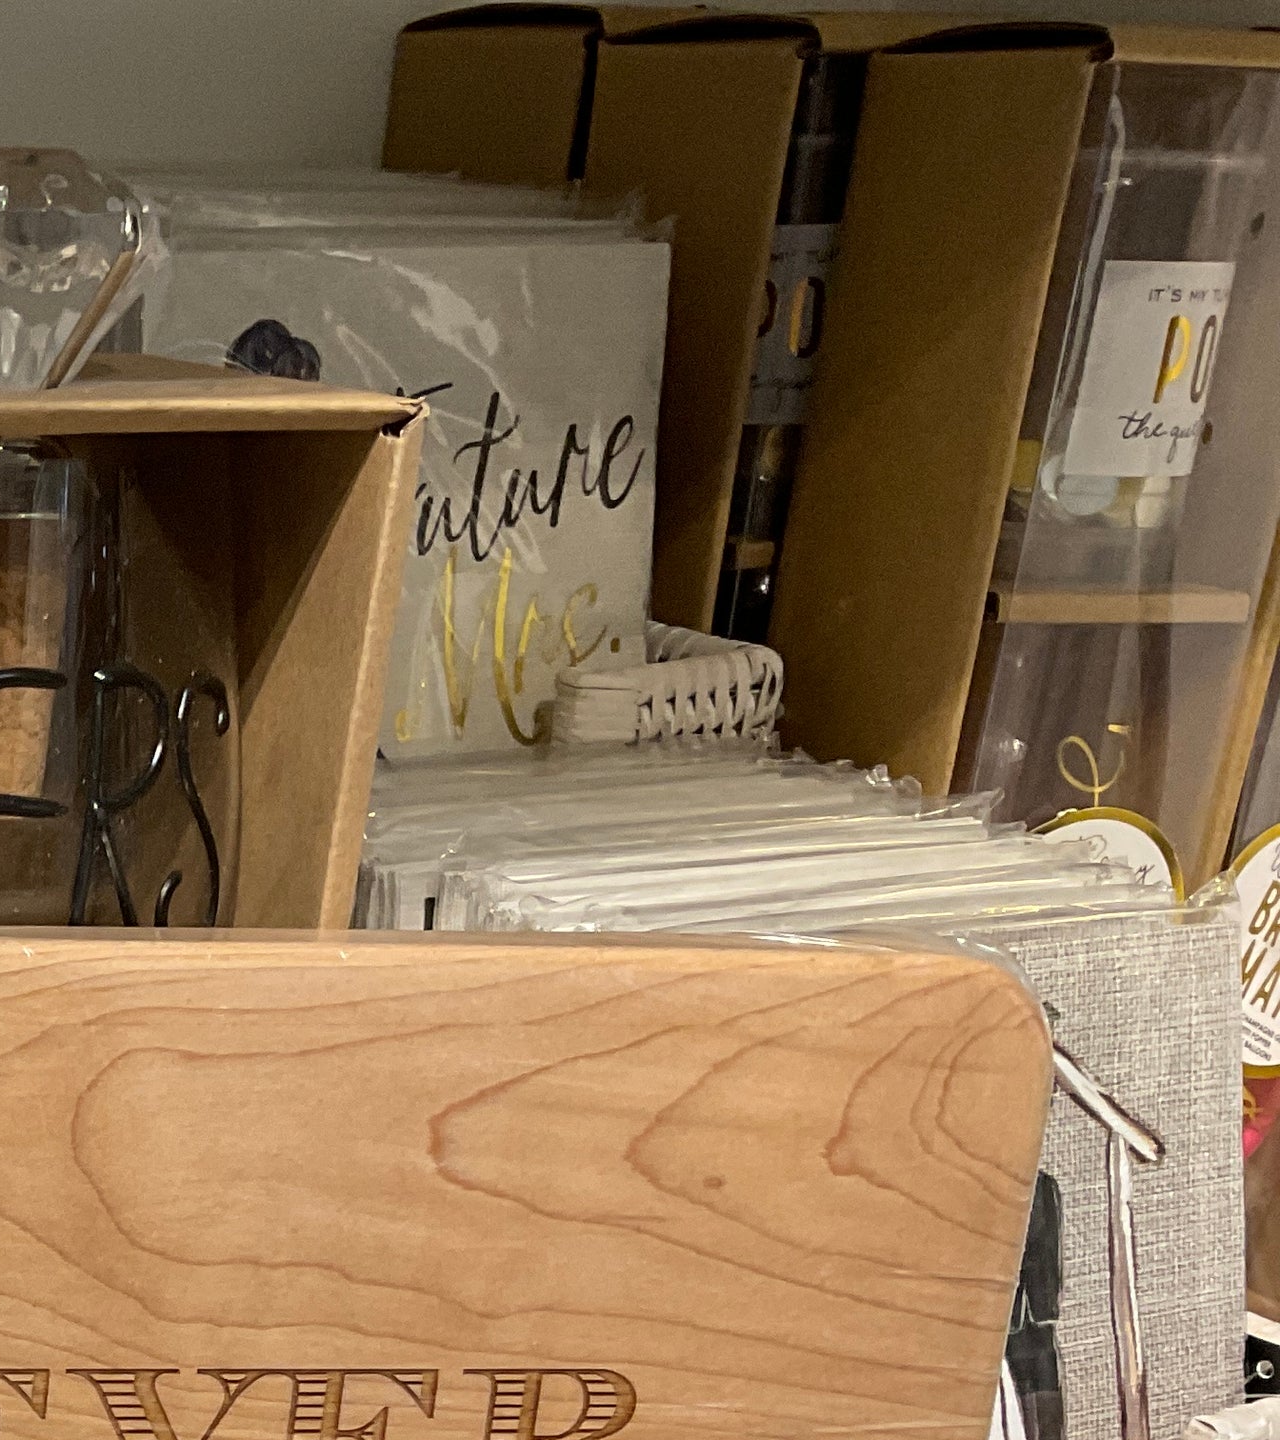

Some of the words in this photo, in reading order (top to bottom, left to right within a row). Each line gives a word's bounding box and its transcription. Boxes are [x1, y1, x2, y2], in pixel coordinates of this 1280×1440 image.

[1148, 285, 1182, 303] IT'S
[1118, 410, 1167, 440] the
[390, 383, 644, 562] uture
